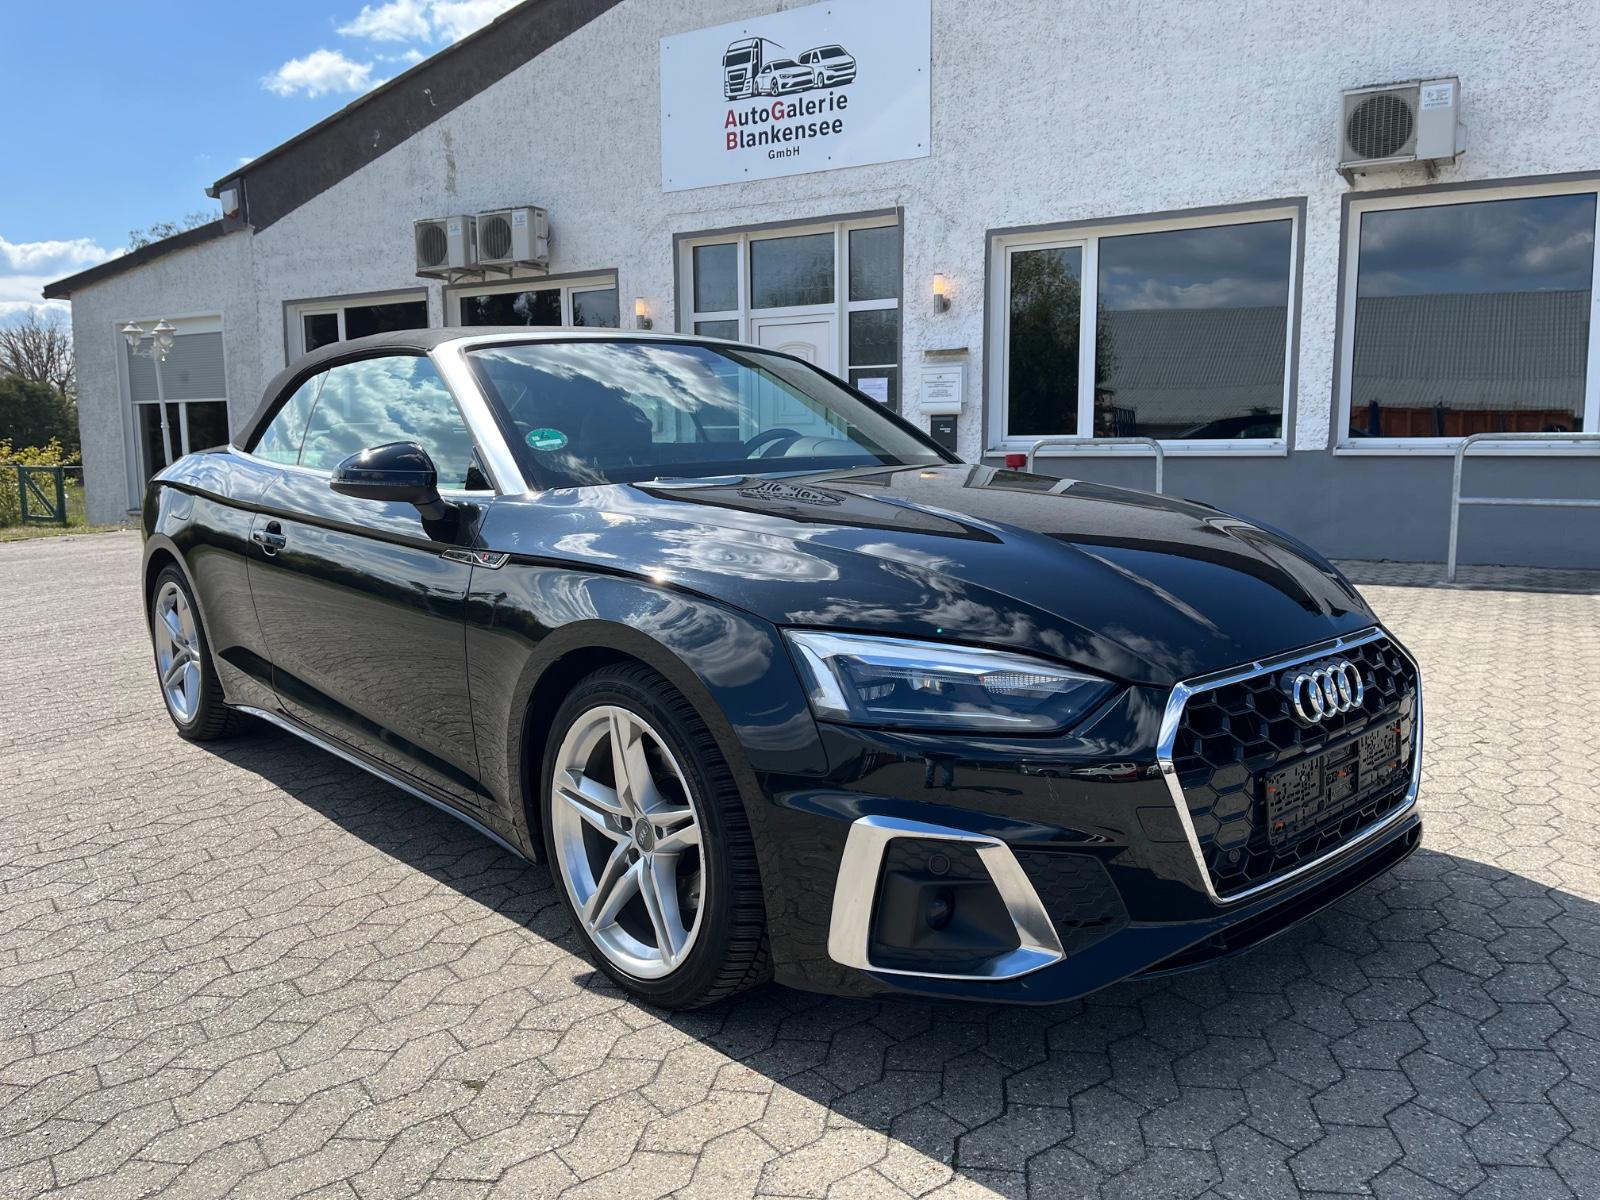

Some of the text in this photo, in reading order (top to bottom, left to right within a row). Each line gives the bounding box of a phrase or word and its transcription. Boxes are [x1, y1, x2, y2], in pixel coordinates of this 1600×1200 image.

[724, 91, 848, 129] AutoGalerie
[726, 118, 843, 151] Blankensee
[768, 146, 800, 160] GmbH
